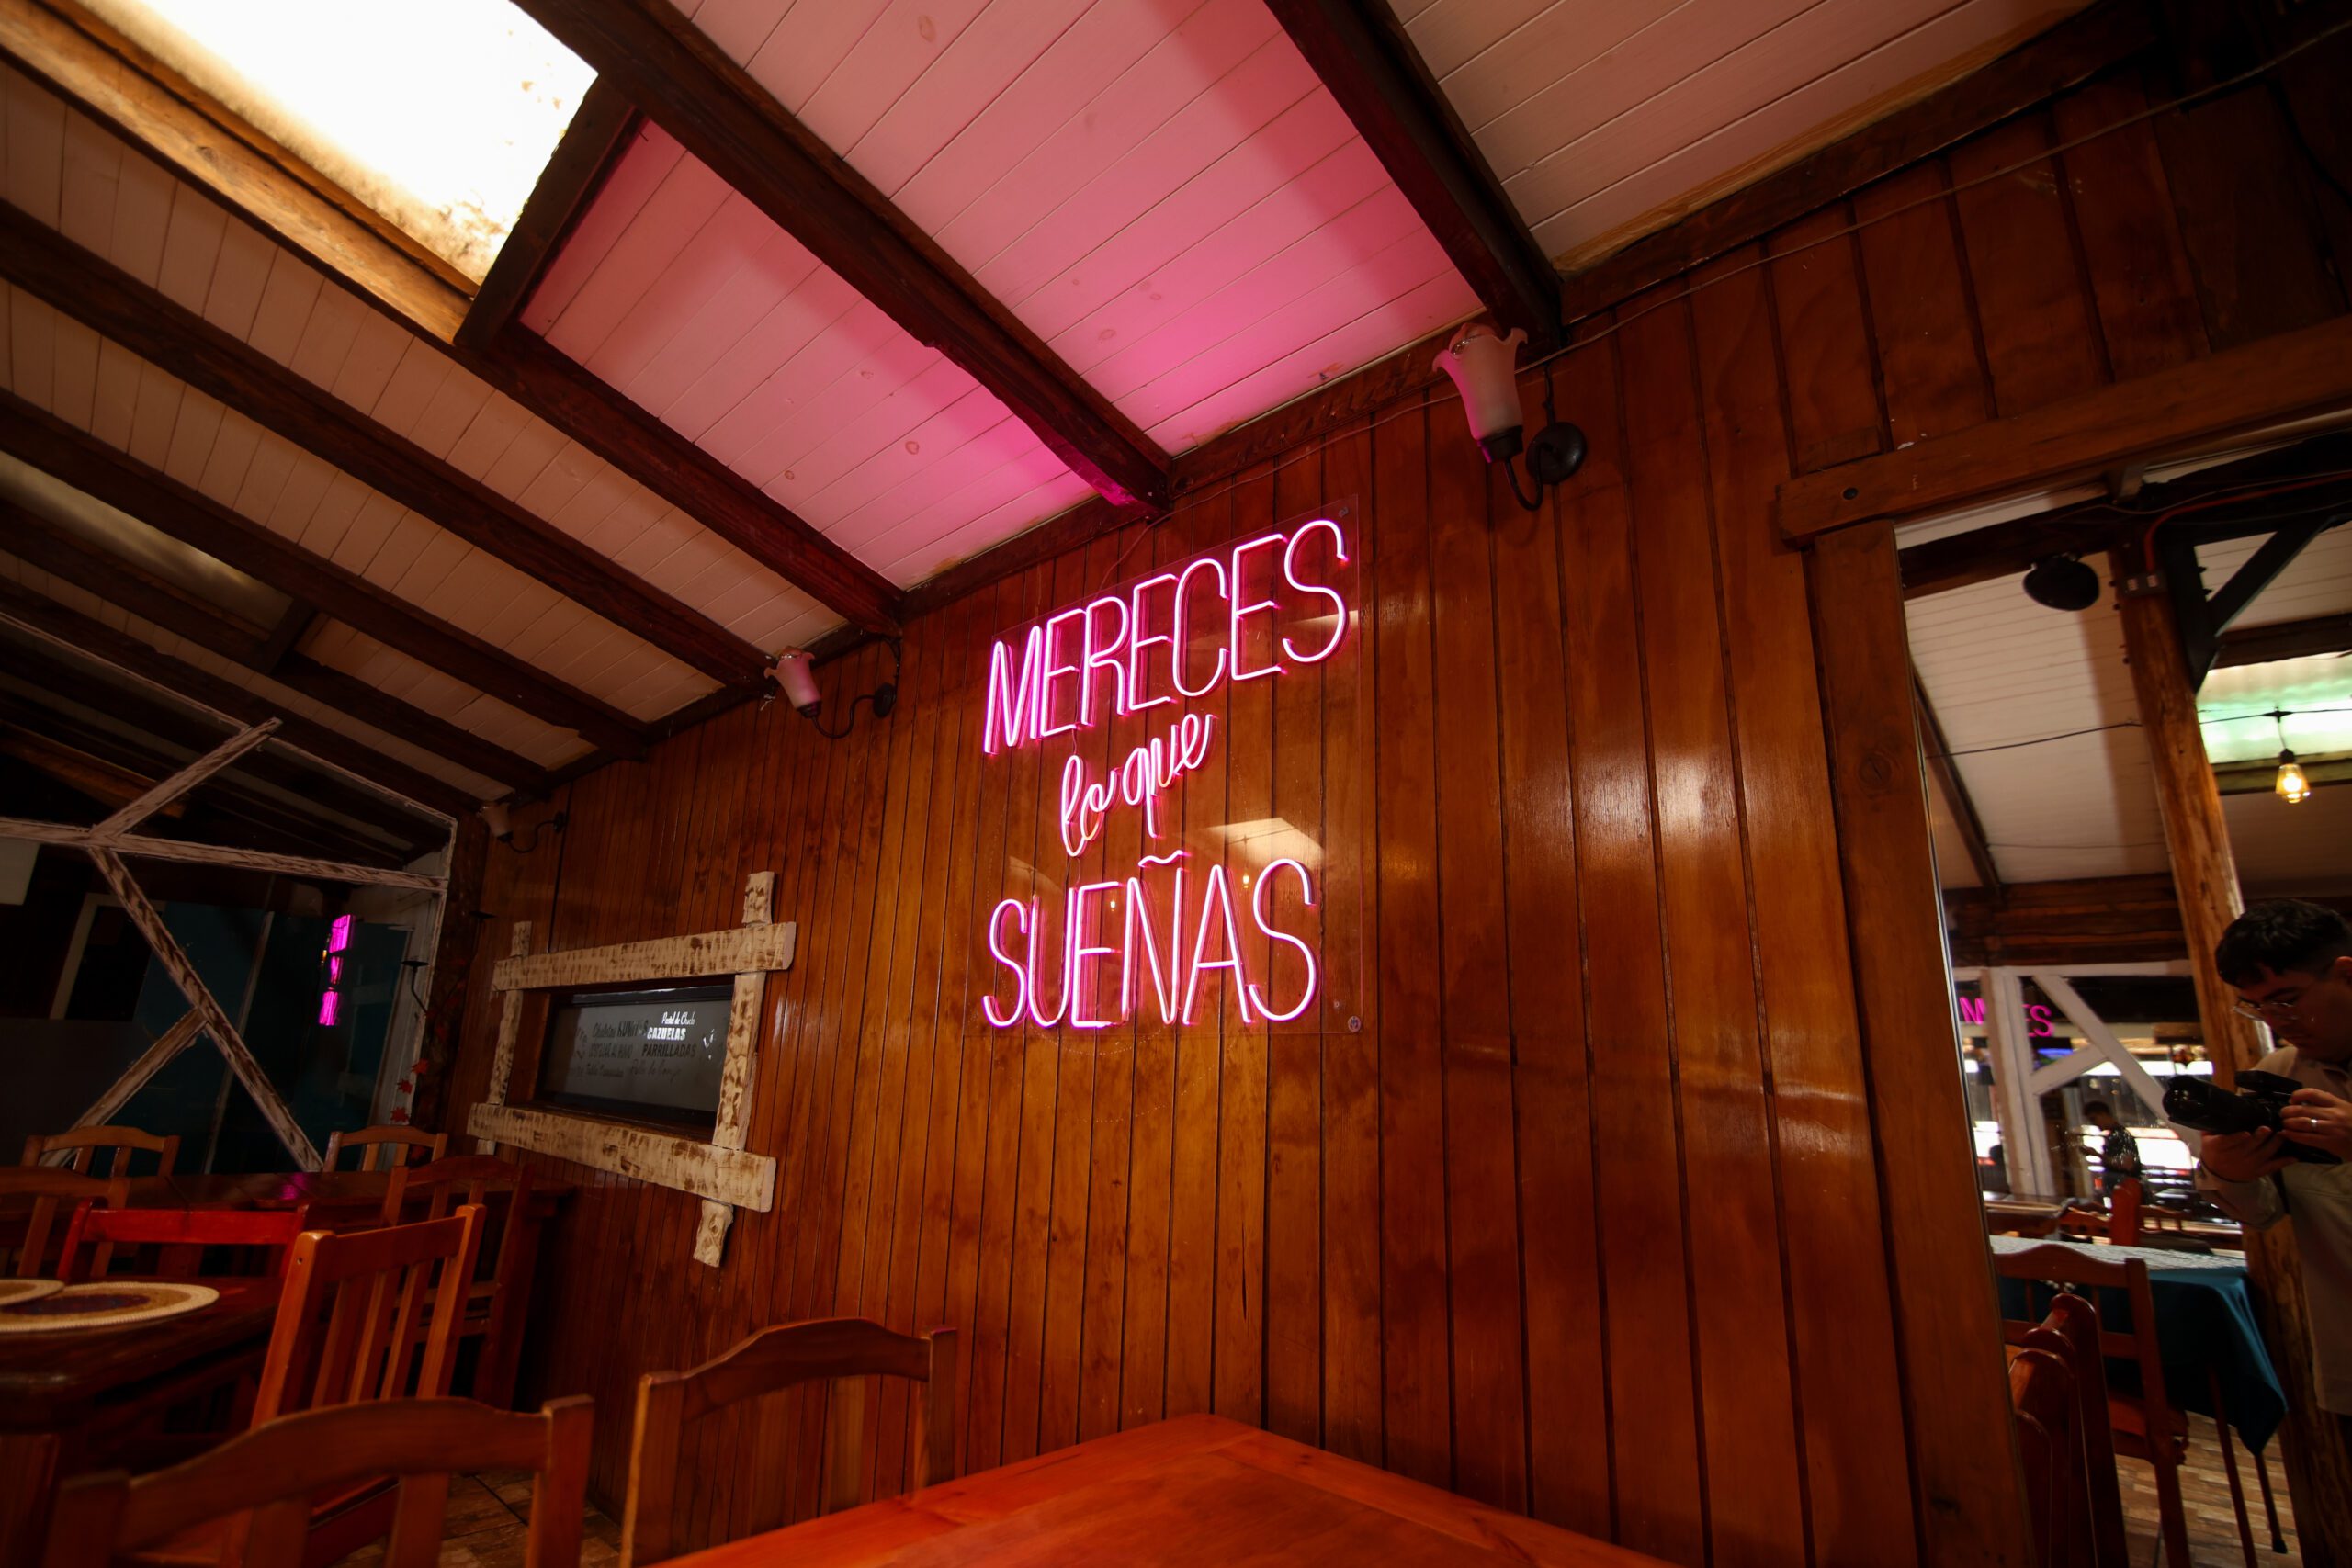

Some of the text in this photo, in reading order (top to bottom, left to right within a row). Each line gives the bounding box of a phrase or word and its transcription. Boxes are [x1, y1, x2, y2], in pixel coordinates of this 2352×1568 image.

[984, 520, 1349, 754] MERECES
[1060, 712, 1216, 857] lo que
[982, 851, 1317, 1028] SUEÑAS
[641, 1043, 697, 1058] PARRILLADAS
[647, 1027, 686, 1041] CAZUELAS
